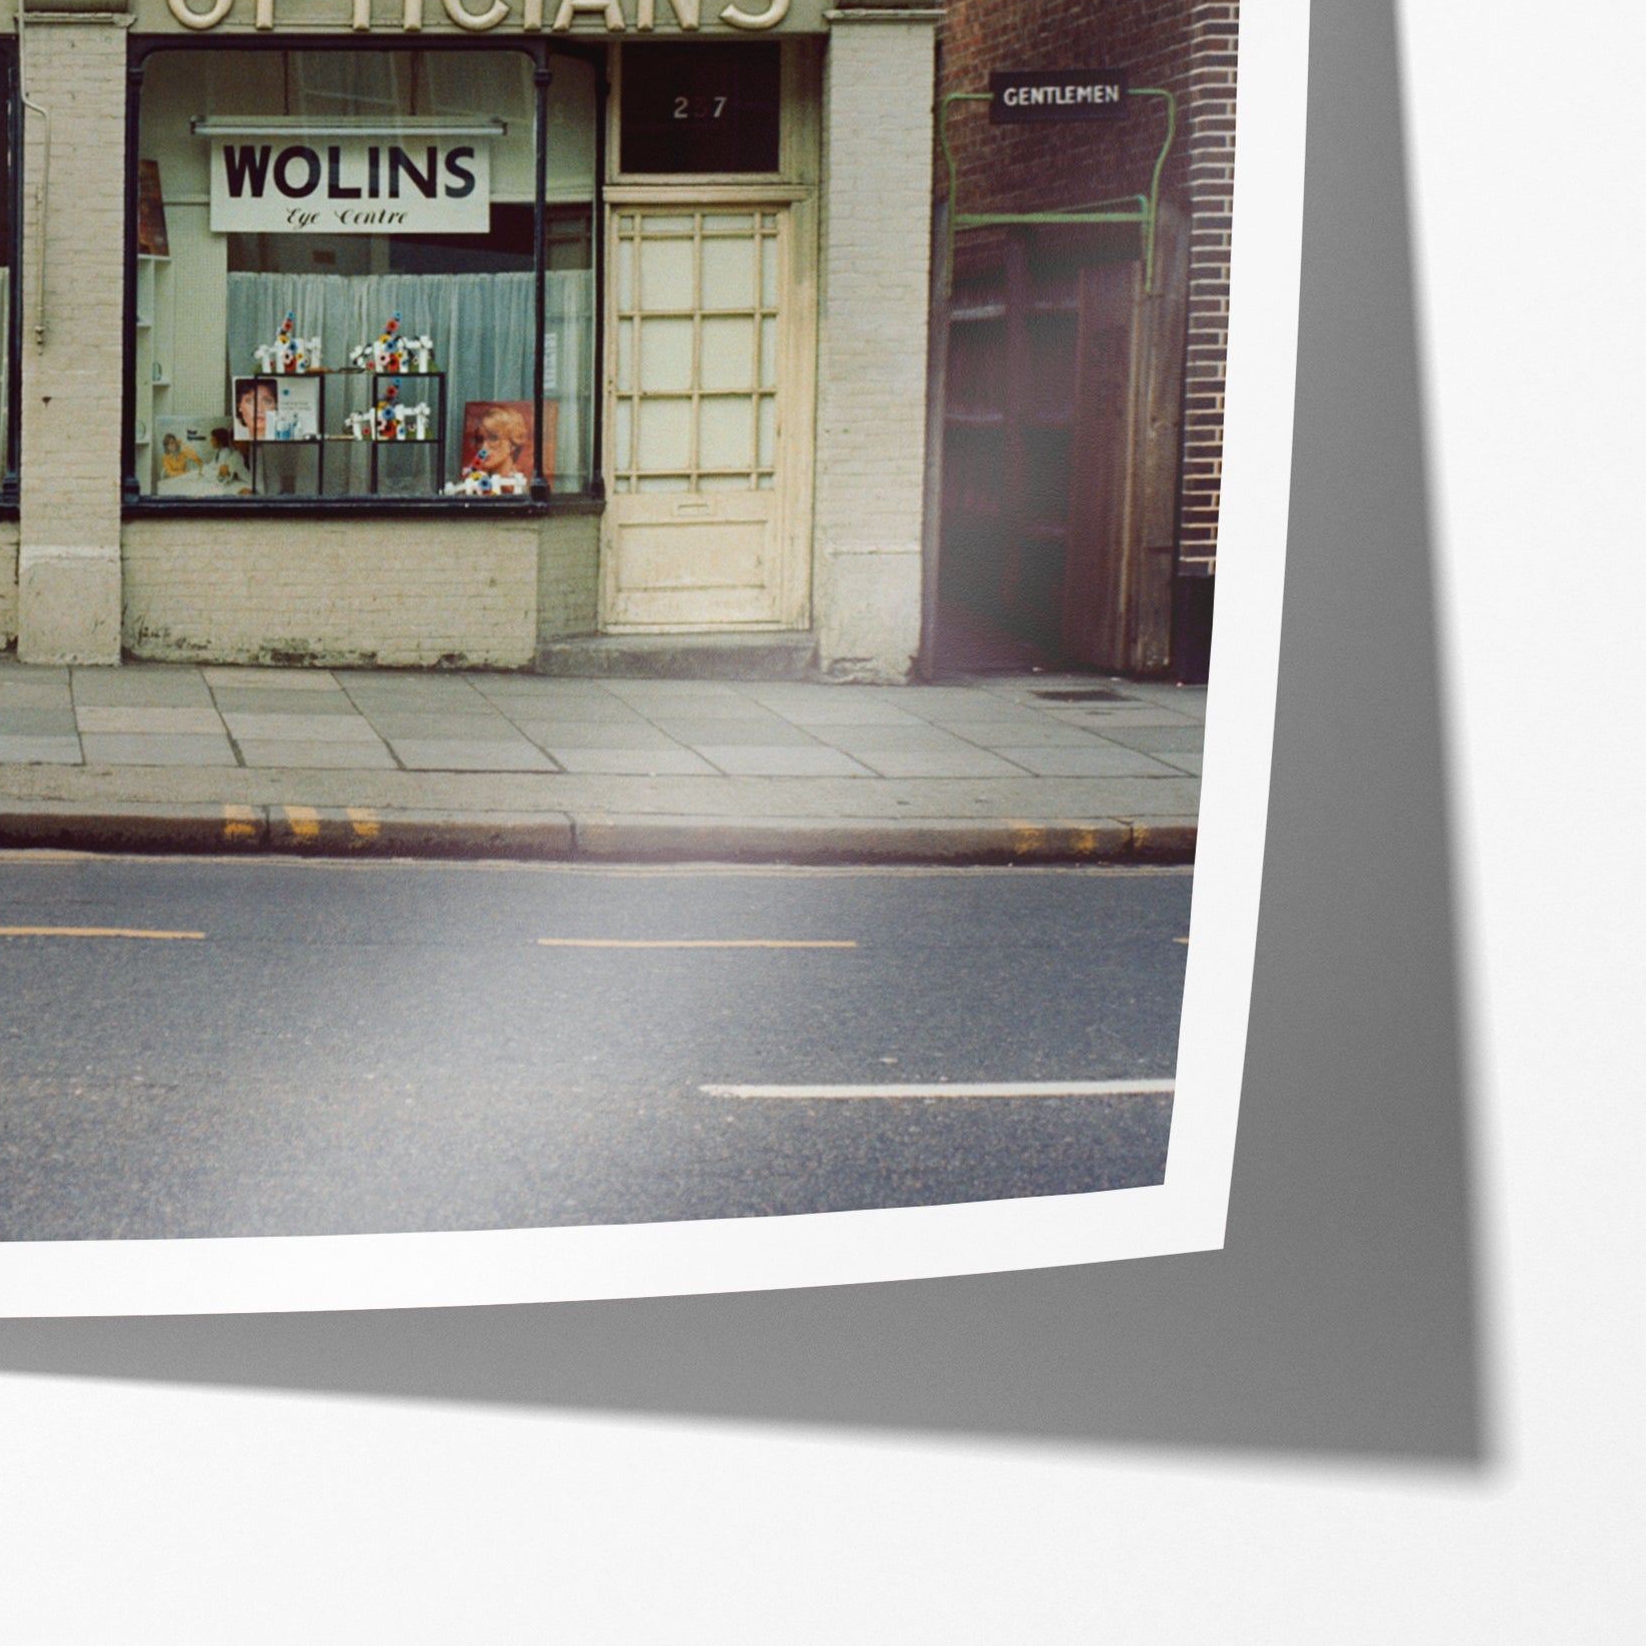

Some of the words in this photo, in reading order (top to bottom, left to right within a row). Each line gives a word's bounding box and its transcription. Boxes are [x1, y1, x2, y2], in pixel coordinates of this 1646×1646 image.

[1003, 85, 1119, 106] GENTLEMEN
[223, 145, 476, 199] WOLINS
[286, 207, 320, 229] Eye
[334, 208, 407, 225] Centre
